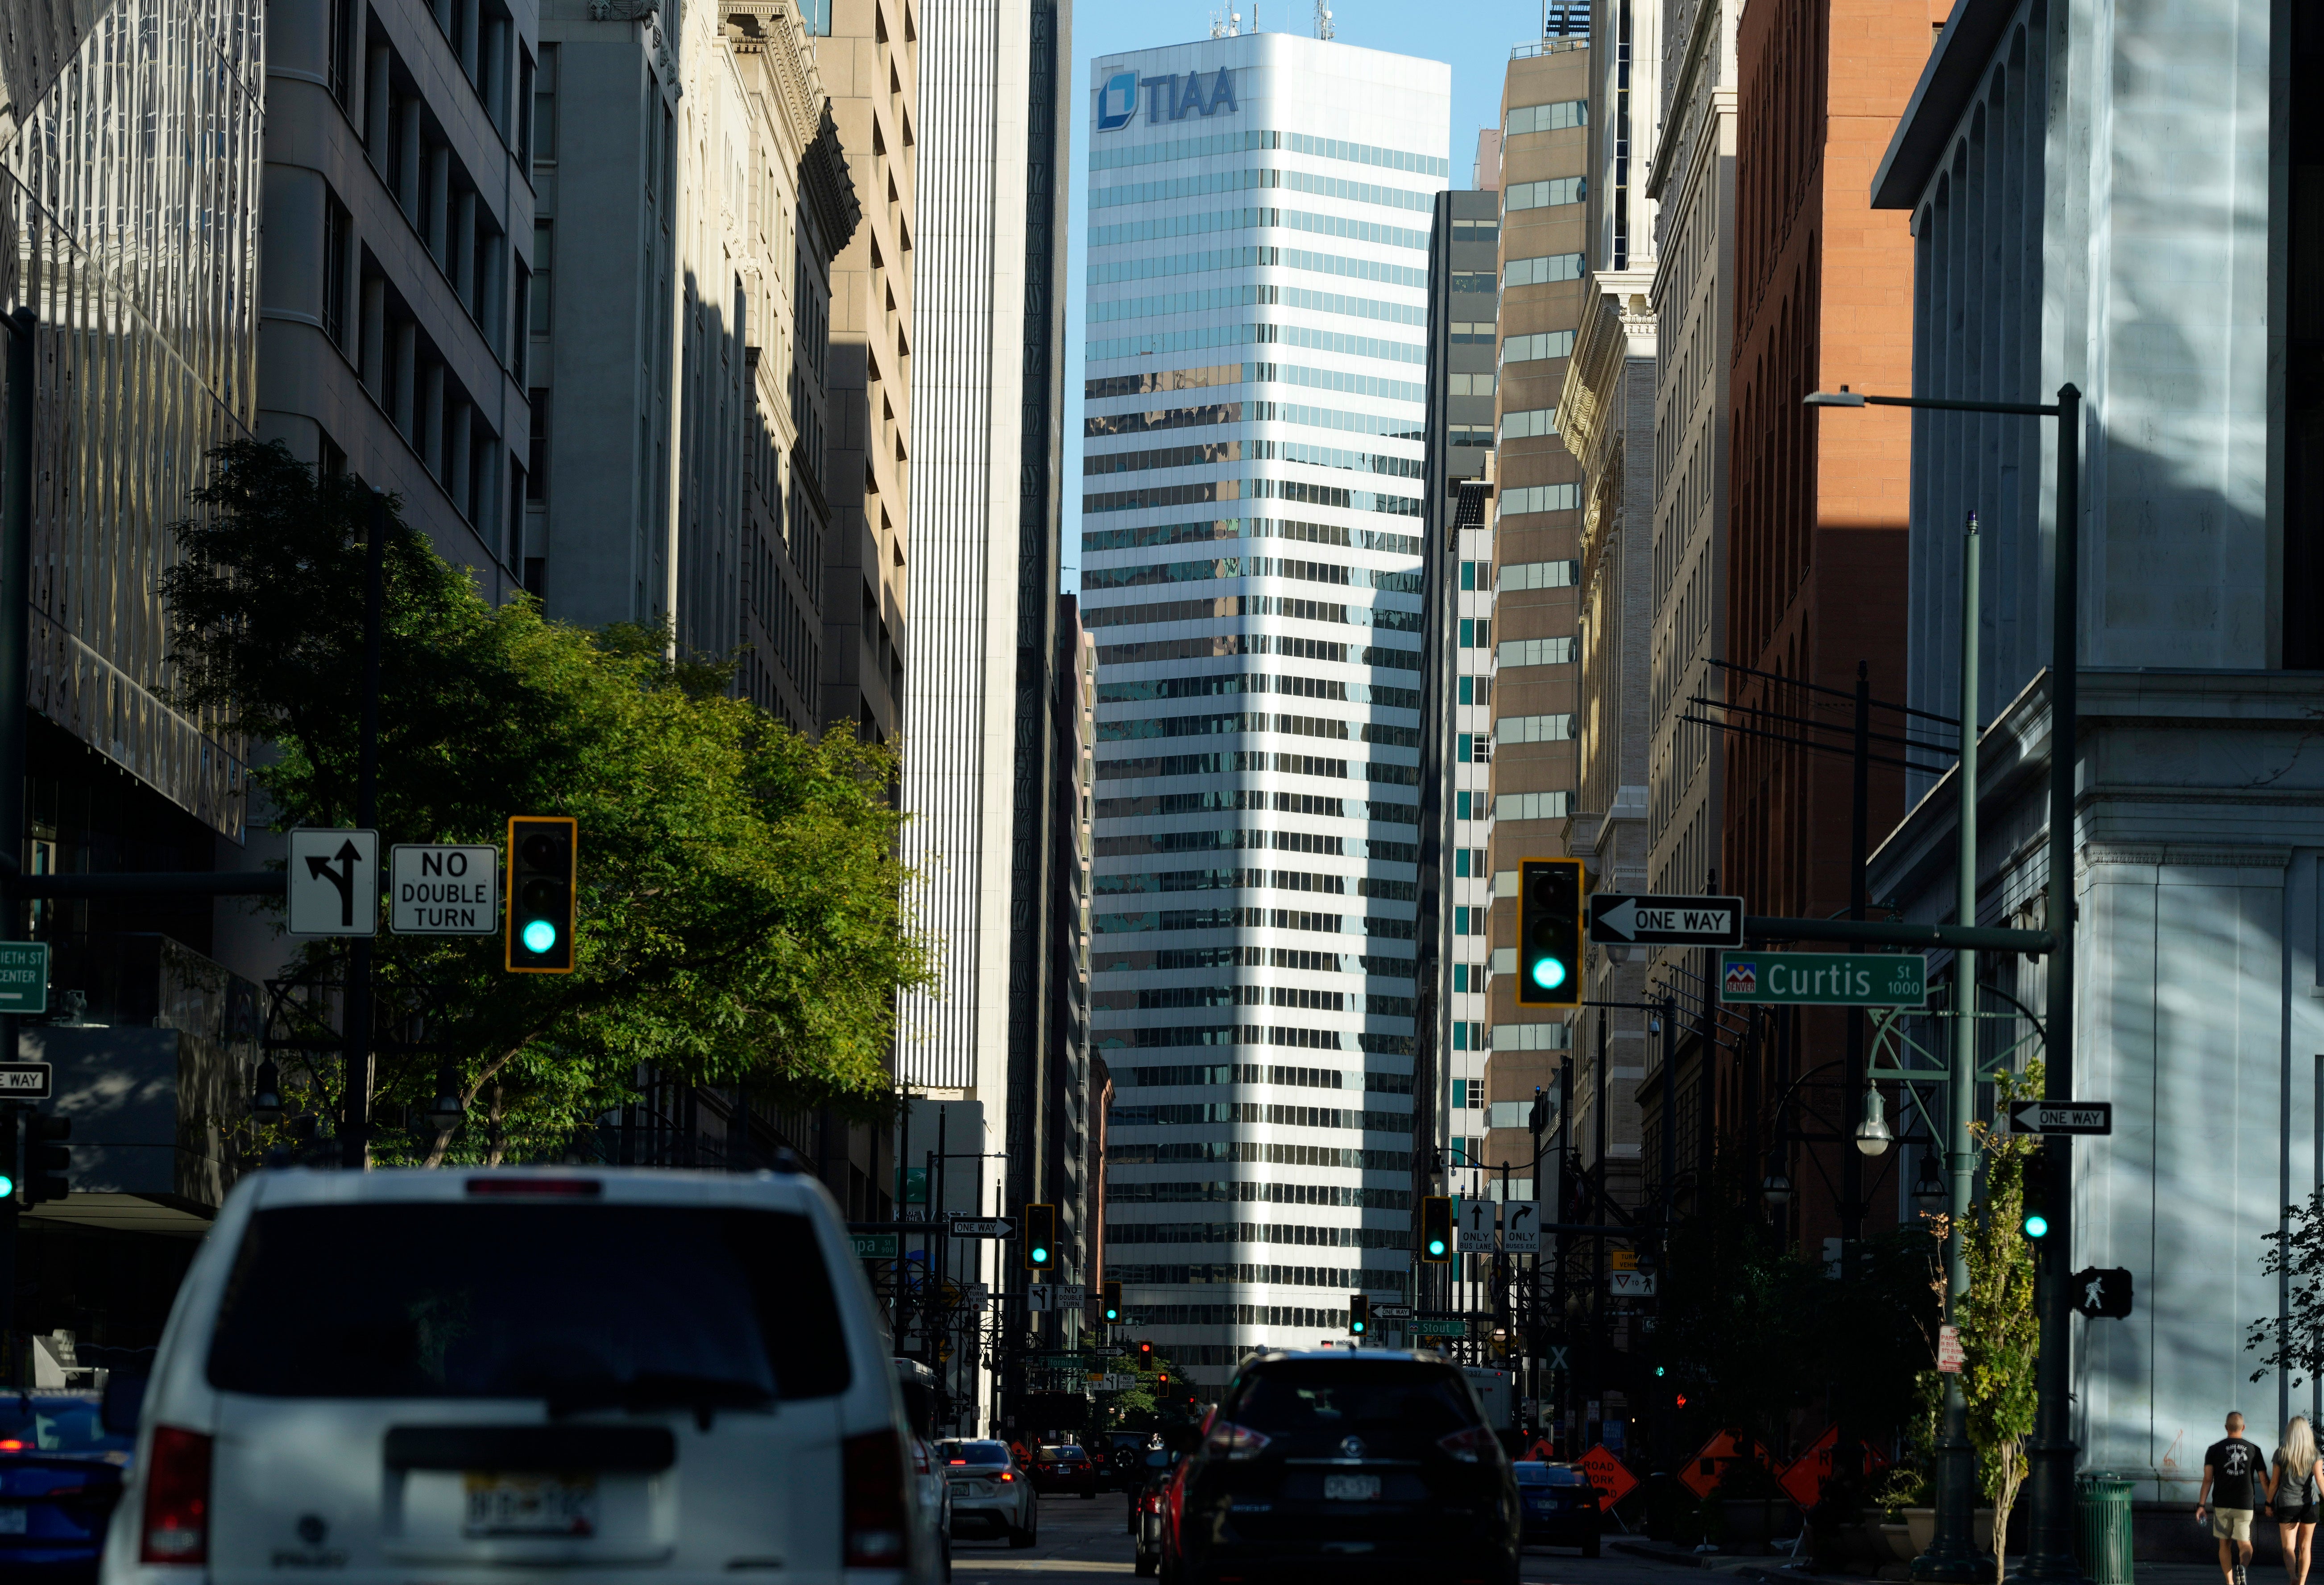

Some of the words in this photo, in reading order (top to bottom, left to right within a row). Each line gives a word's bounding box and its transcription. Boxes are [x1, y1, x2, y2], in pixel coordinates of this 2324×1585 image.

[1142, 66, 1238, 123] TIAA
[422, 852, 468, 877] NO
[402, 884, 486, 903] DOUBLE
[414, 908, 475, 927] TURN
[1636, 911, 1675, 929] ONE
[1684, 912, 1725, 930] WAY
[29, 951, 43, 965] ST
[1897, 965, 1911, 979] St
[1768, 962, 1871, 997] Curtis
[1726, 982, 1755, 992] DENVER
[1888, 981, 1920, 996] 1000
[11, 1074, 39, 1087] WAY
[2040, 1111, 2067, 1124] ONE
[2072, 1112, 2100, 1124] WAY
[957, 1223, 974, 1232] ONE
[978, 1223, 996, 1232] WAY
[1463, 1232, 1489, 1241] ONLY
[1509, 1232, 1535, 1241] ONLY
[1423, 1323, 1450, 1332] Stout
[1584, 1461, 1614, 1471] ROAD
